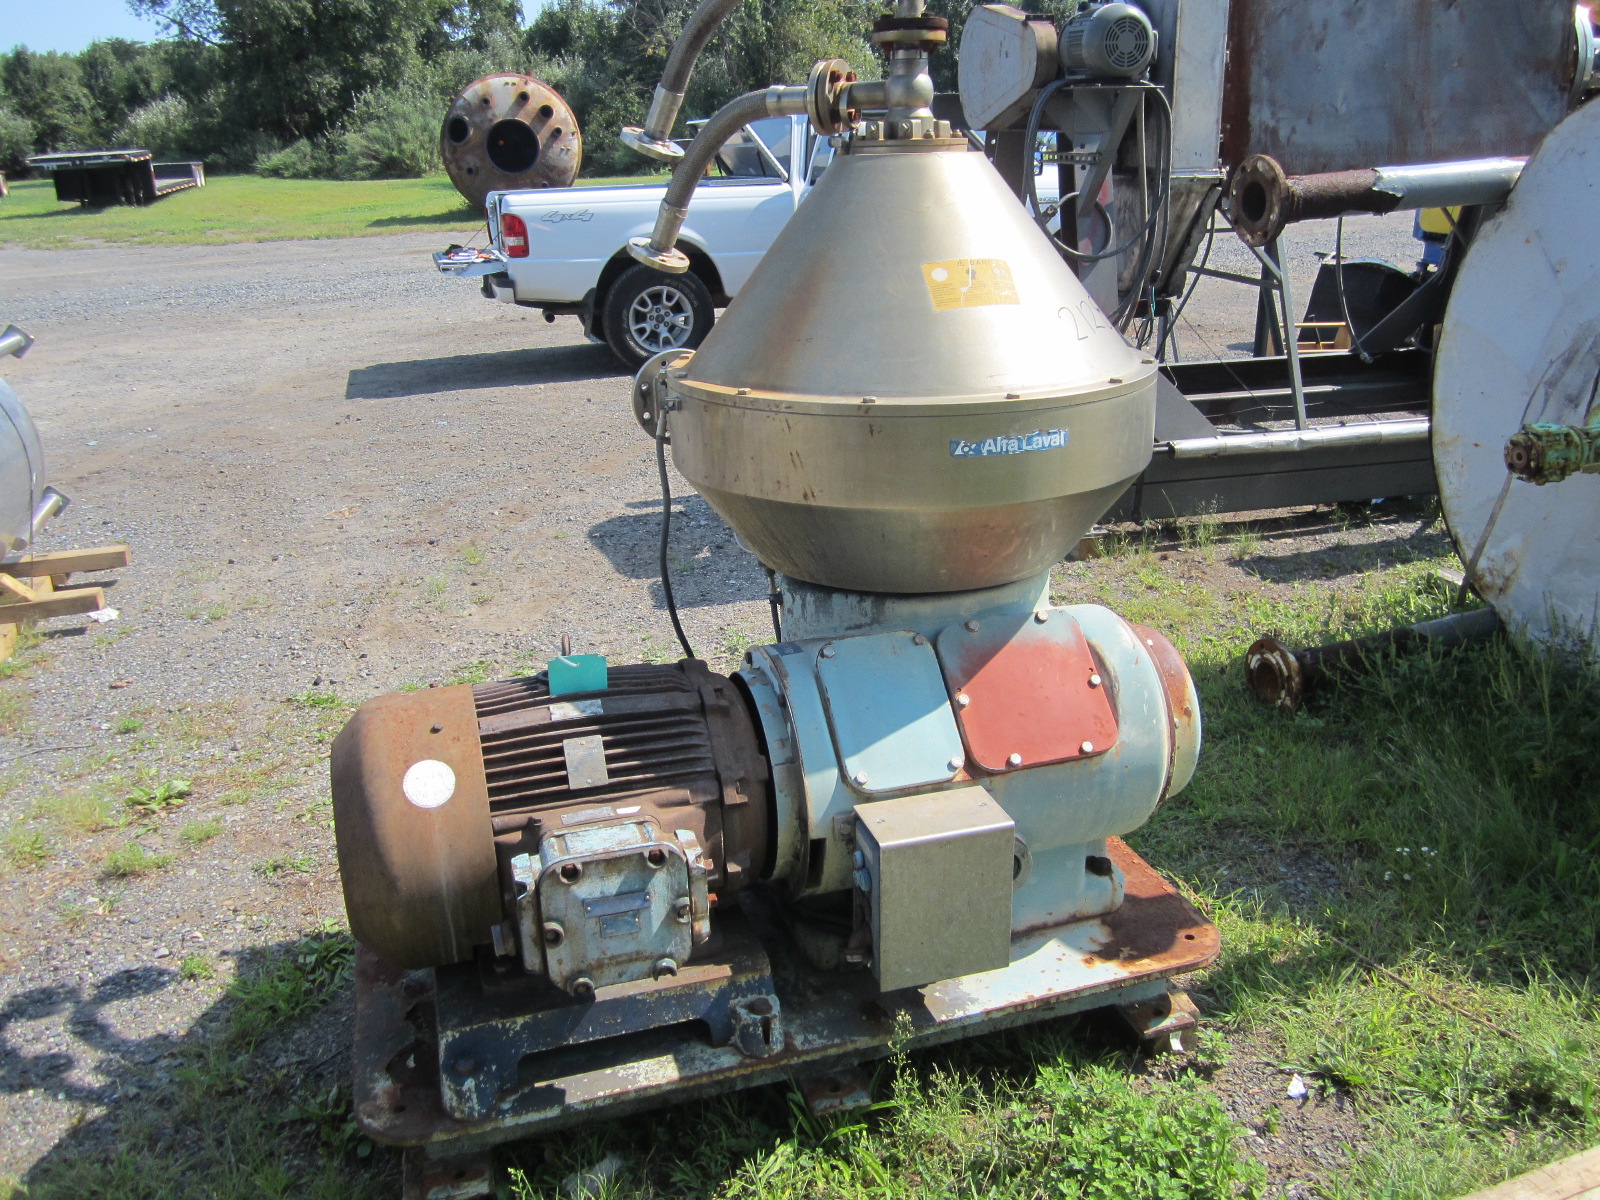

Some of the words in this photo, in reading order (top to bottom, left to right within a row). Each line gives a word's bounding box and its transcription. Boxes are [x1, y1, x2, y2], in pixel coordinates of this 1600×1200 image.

[541, 210, 594, 223] 4x4
[983, 436, 1018, 454] Alfa
[1022, 429, 1065, 450] Laval
